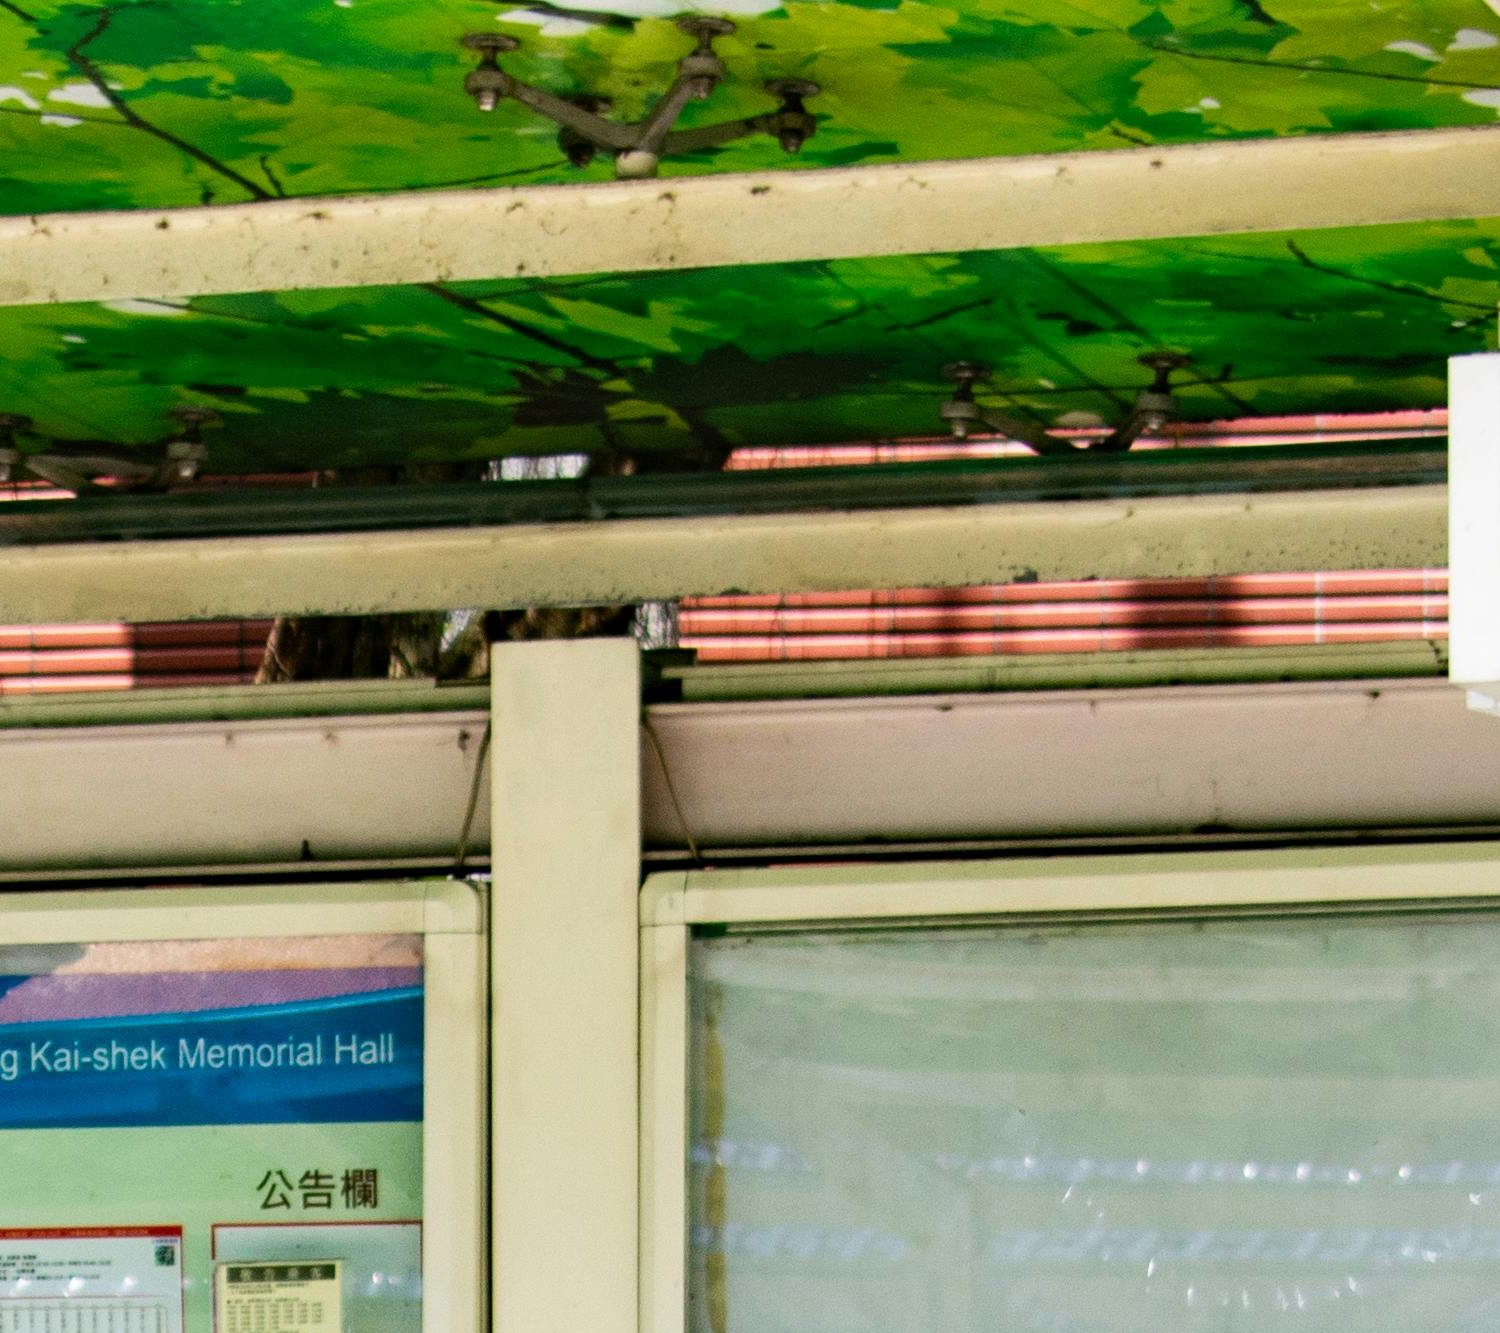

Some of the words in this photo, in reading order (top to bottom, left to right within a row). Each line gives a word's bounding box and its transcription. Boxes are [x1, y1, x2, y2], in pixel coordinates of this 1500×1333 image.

[30, 1039, 167, 1073] Kai-shek
[178, 1036, 321, 1069] Memorial
[335, 1033, 394, 1065] Hall
[255, 1168, 380, 1211] 公告欄
